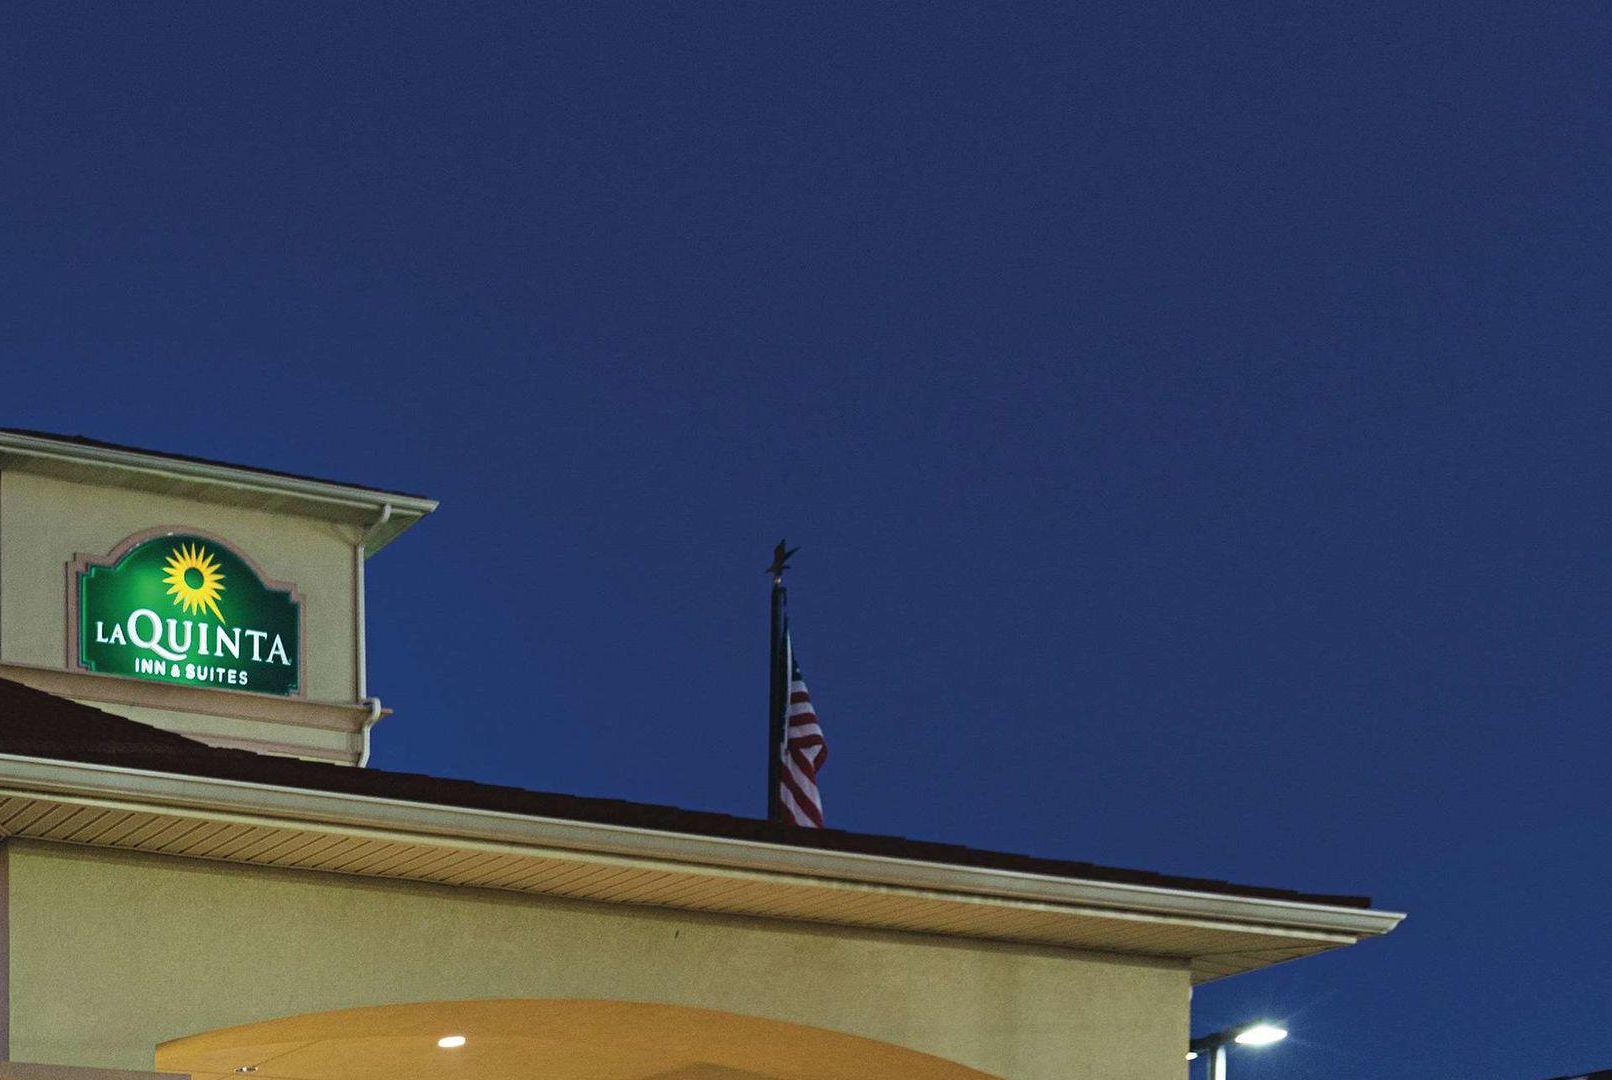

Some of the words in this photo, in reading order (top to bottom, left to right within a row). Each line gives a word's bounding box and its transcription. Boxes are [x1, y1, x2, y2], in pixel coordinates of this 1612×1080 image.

[134, 657, 166, 676] INN
[170, 663, 181, 679] &
[185, 662, 249, 686] SUITES
